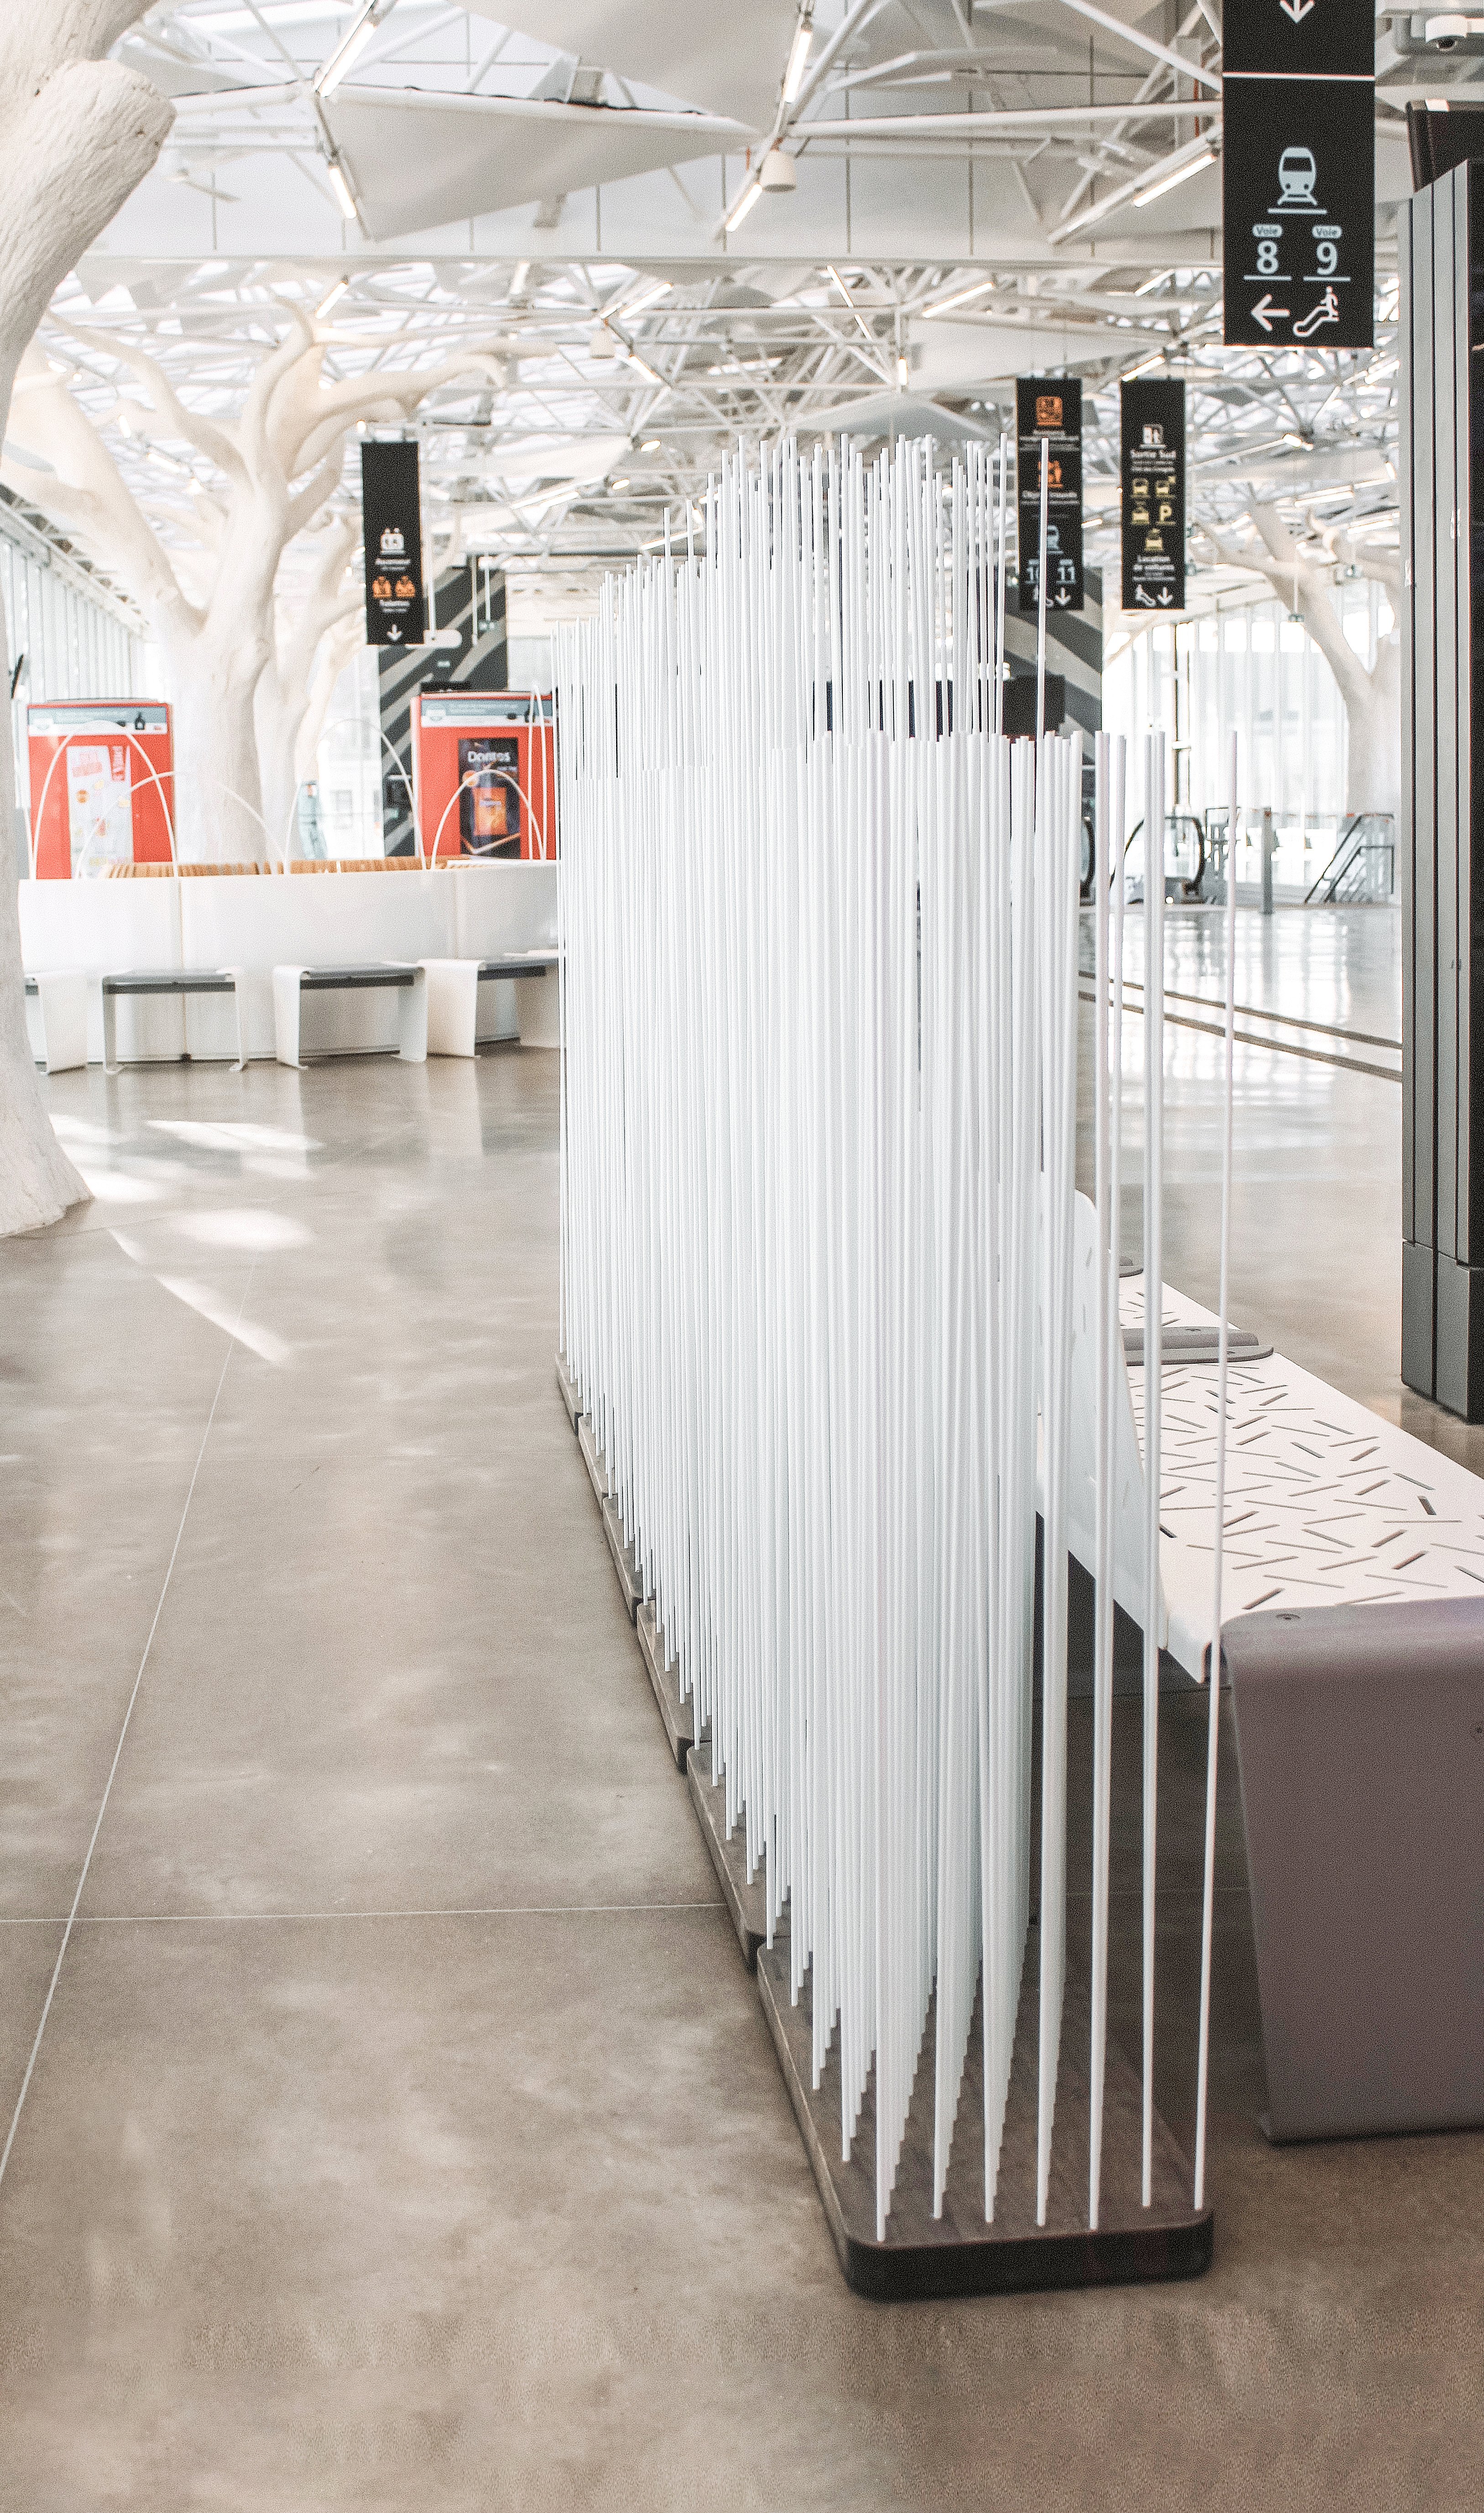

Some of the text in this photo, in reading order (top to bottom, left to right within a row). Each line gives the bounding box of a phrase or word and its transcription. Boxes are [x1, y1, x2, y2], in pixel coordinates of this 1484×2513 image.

[1256, 227, 1278, 236] Voie
[1316, 228, 1338, 236] Voie
[1256, 241, 1279, 274] 8
[1316, 241, 1338, 276] 9
[1057, 566, 1075, 580] 11
